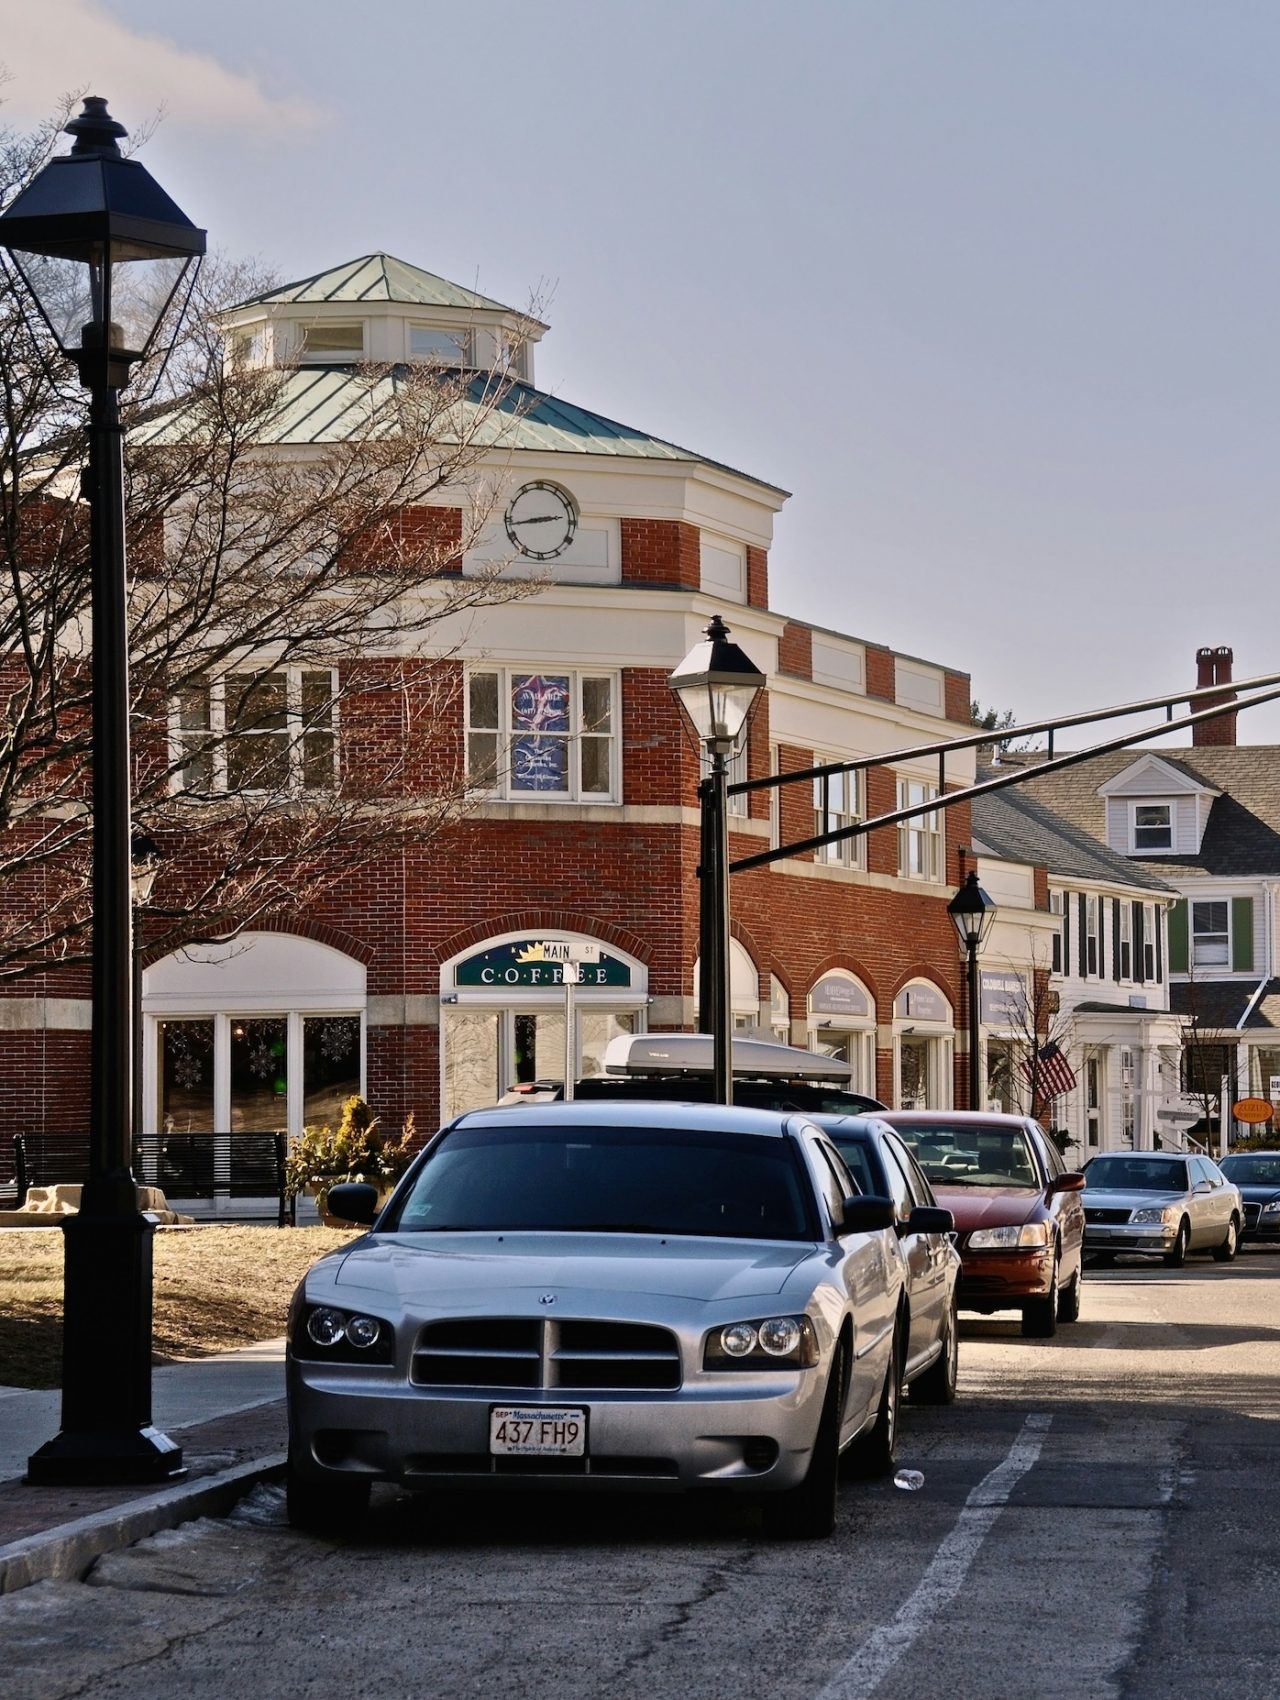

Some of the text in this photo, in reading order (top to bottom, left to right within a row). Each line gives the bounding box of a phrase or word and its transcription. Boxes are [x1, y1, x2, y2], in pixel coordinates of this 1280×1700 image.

[543, 944, 594, 959] MAIN ST
[481, 968, 607, 983] COFFEE
[495, 1421, 579, 1444] 437 FH9
